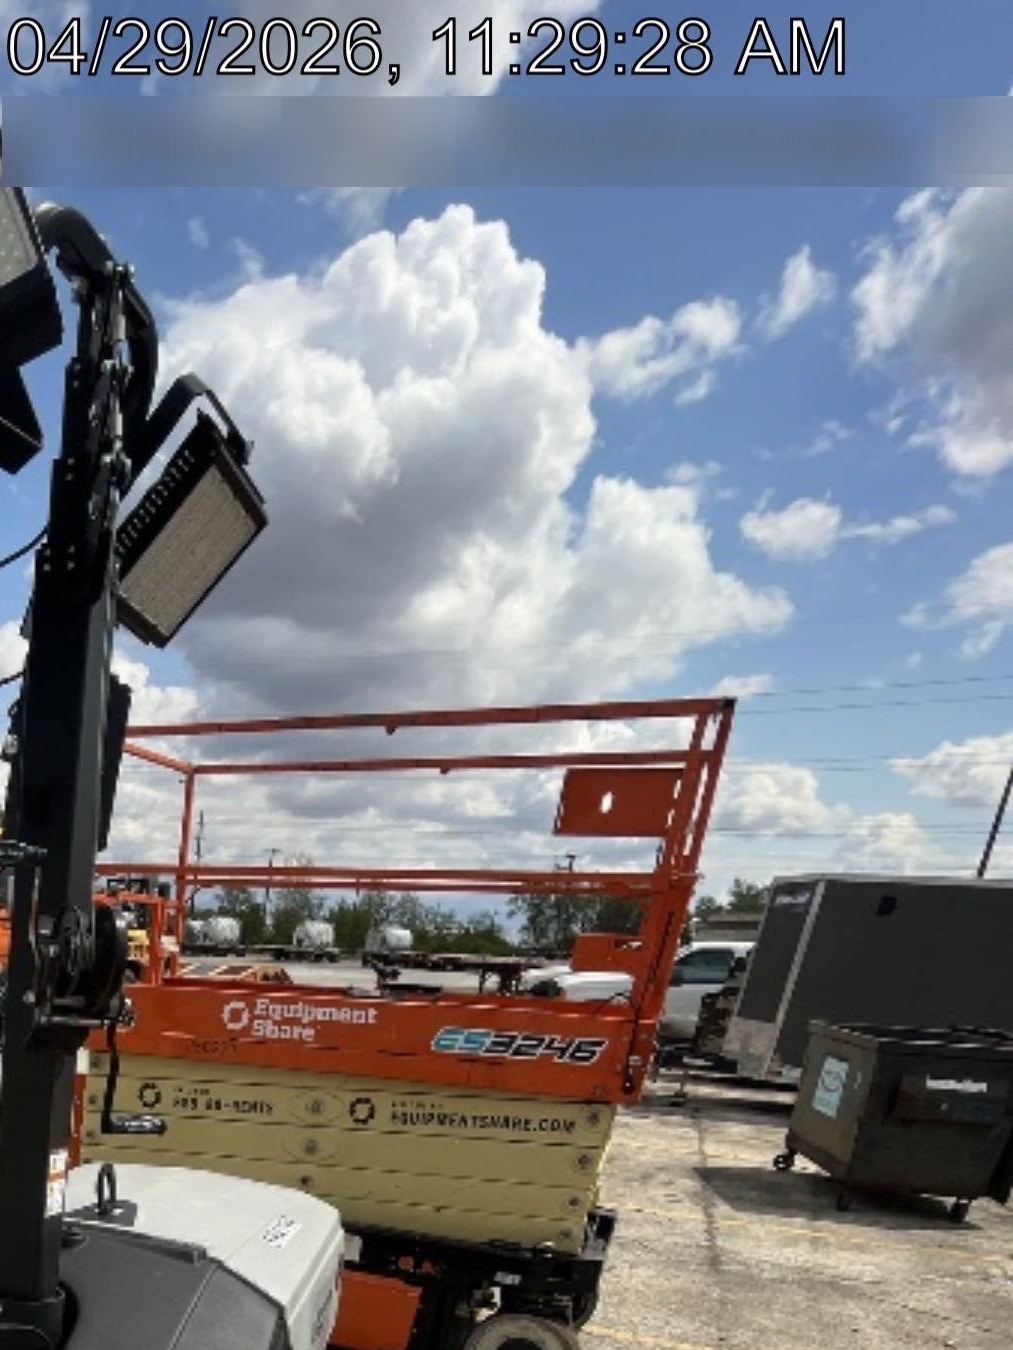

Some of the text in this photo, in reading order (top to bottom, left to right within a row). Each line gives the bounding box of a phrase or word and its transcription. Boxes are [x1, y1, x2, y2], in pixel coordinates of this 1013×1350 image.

[254, 998, 378, 1024] Equipment
[251, 1020, 315, 1041] Share
[432, 1025, 607, 1065] ES3246
